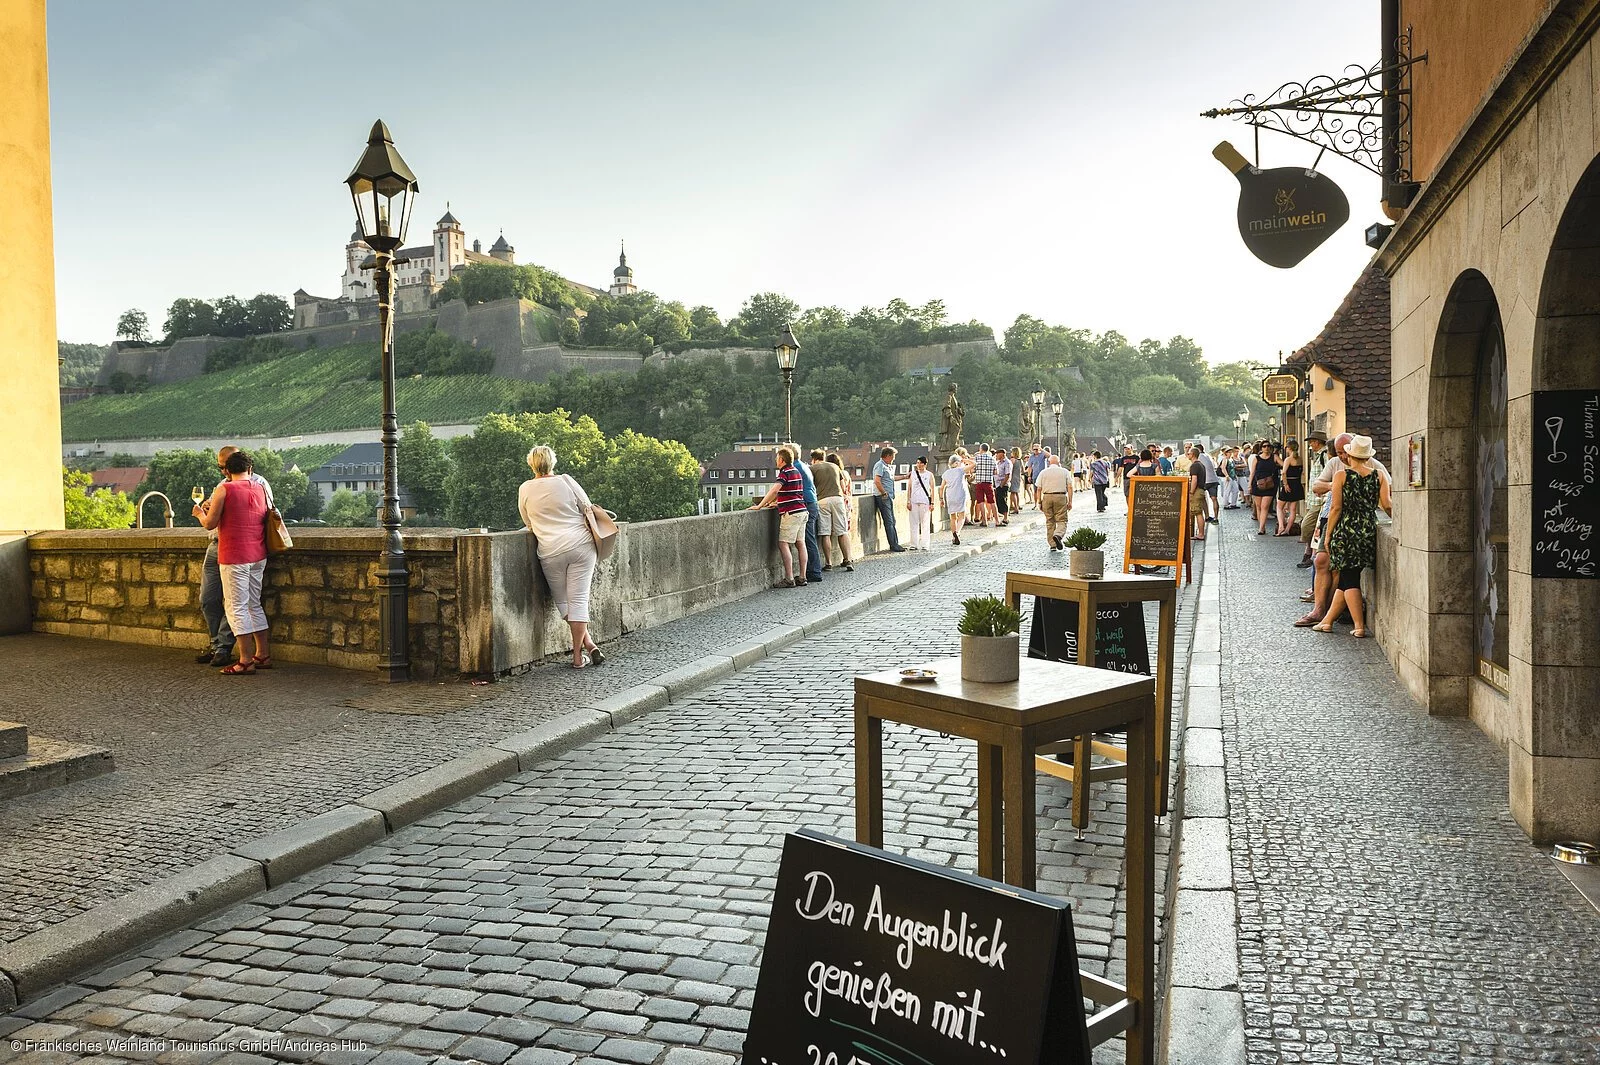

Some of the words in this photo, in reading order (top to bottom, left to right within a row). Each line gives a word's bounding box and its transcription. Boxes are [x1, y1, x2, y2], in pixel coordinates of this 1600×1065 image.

[1249, 210, 1327, 231] mainwein
[1584, 395, 1599, 438] Tilman
[1583, 445, 1599, 484] Secco
[1549, 479, 1584, 496] weiß
[1544, 499, 1568, 518] rot
[1576, 562, 1596, 576] €
[1096, 610, 1120, 620] ecco
[1058, 631, 1078, 664] lman
[795, 871, 855, 927] Den
[864, 884, 1008, 971] Augenblick
[804, 960, 921, 1025] genießen
